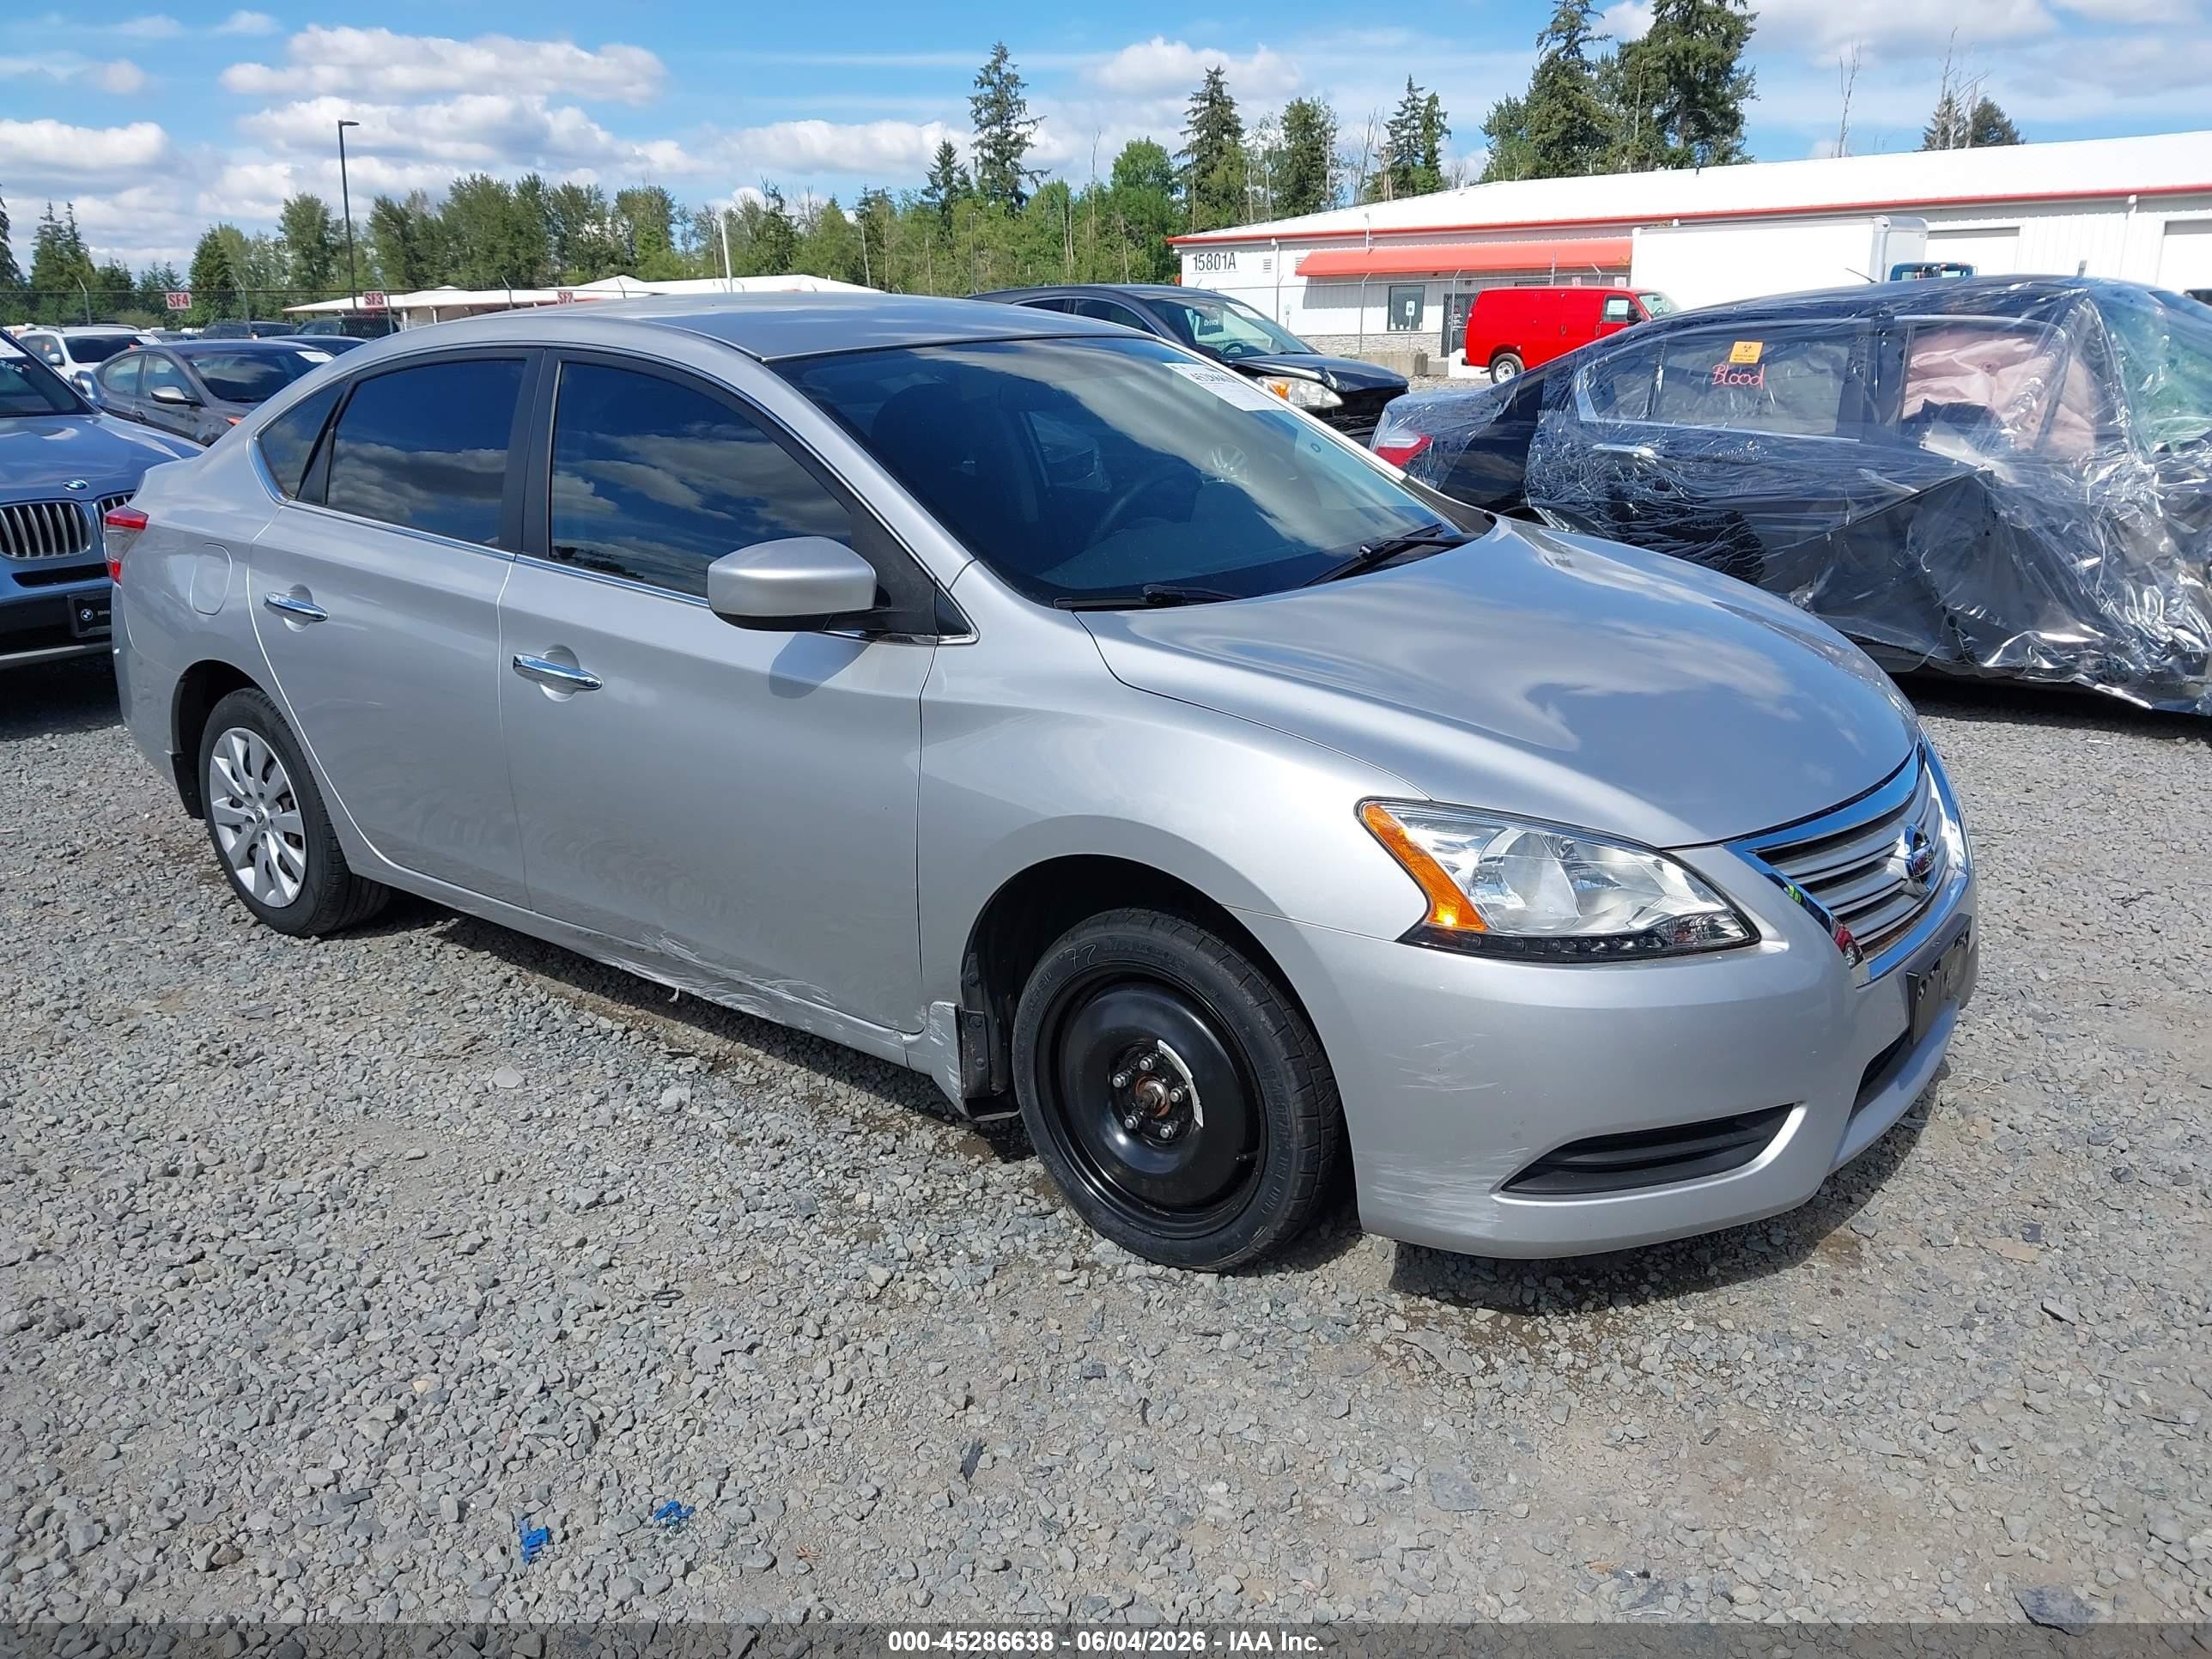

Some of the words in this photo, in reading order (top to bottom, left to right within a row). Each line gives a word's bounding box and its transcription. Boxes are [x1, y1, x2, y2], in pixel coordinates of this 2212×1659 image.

[1192, 252, 1237, 271] 15801A
[167, 294, 190, 307] SF4
[365, 293, 384, 305] SF3
[1711, 363, 1765, 391] Blood
